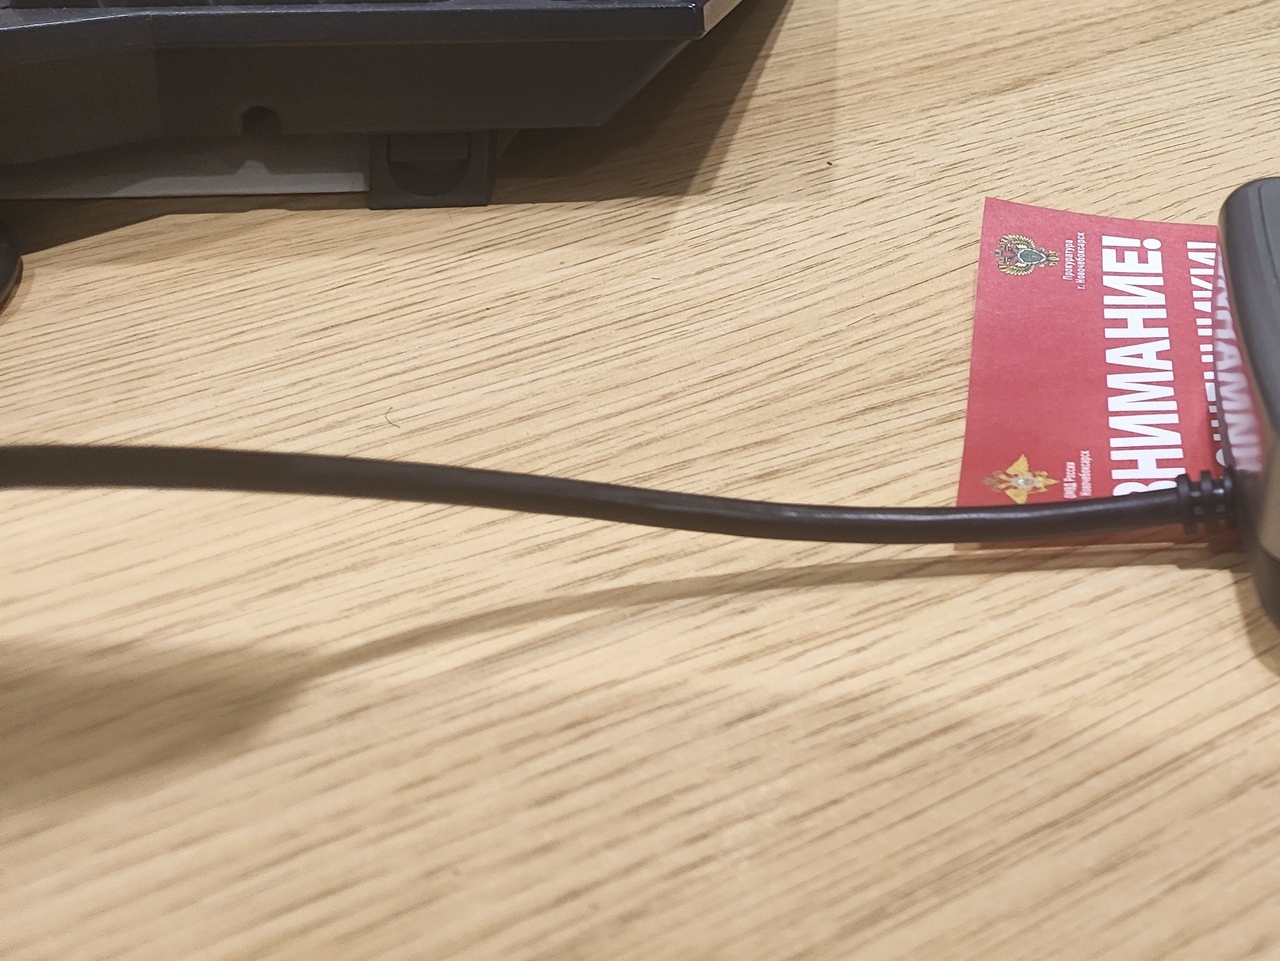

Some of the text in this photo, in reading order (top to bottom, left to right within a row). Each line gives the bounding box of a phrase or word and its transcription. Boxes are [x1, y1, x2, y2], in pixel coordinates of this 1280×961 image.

[1062, 239, 1075, 281] Прокуратура
[1075, 232, 1087, 283] Новочебоксарск
[1101, 235, 1186, 497] ВНИМАНИЕ!
